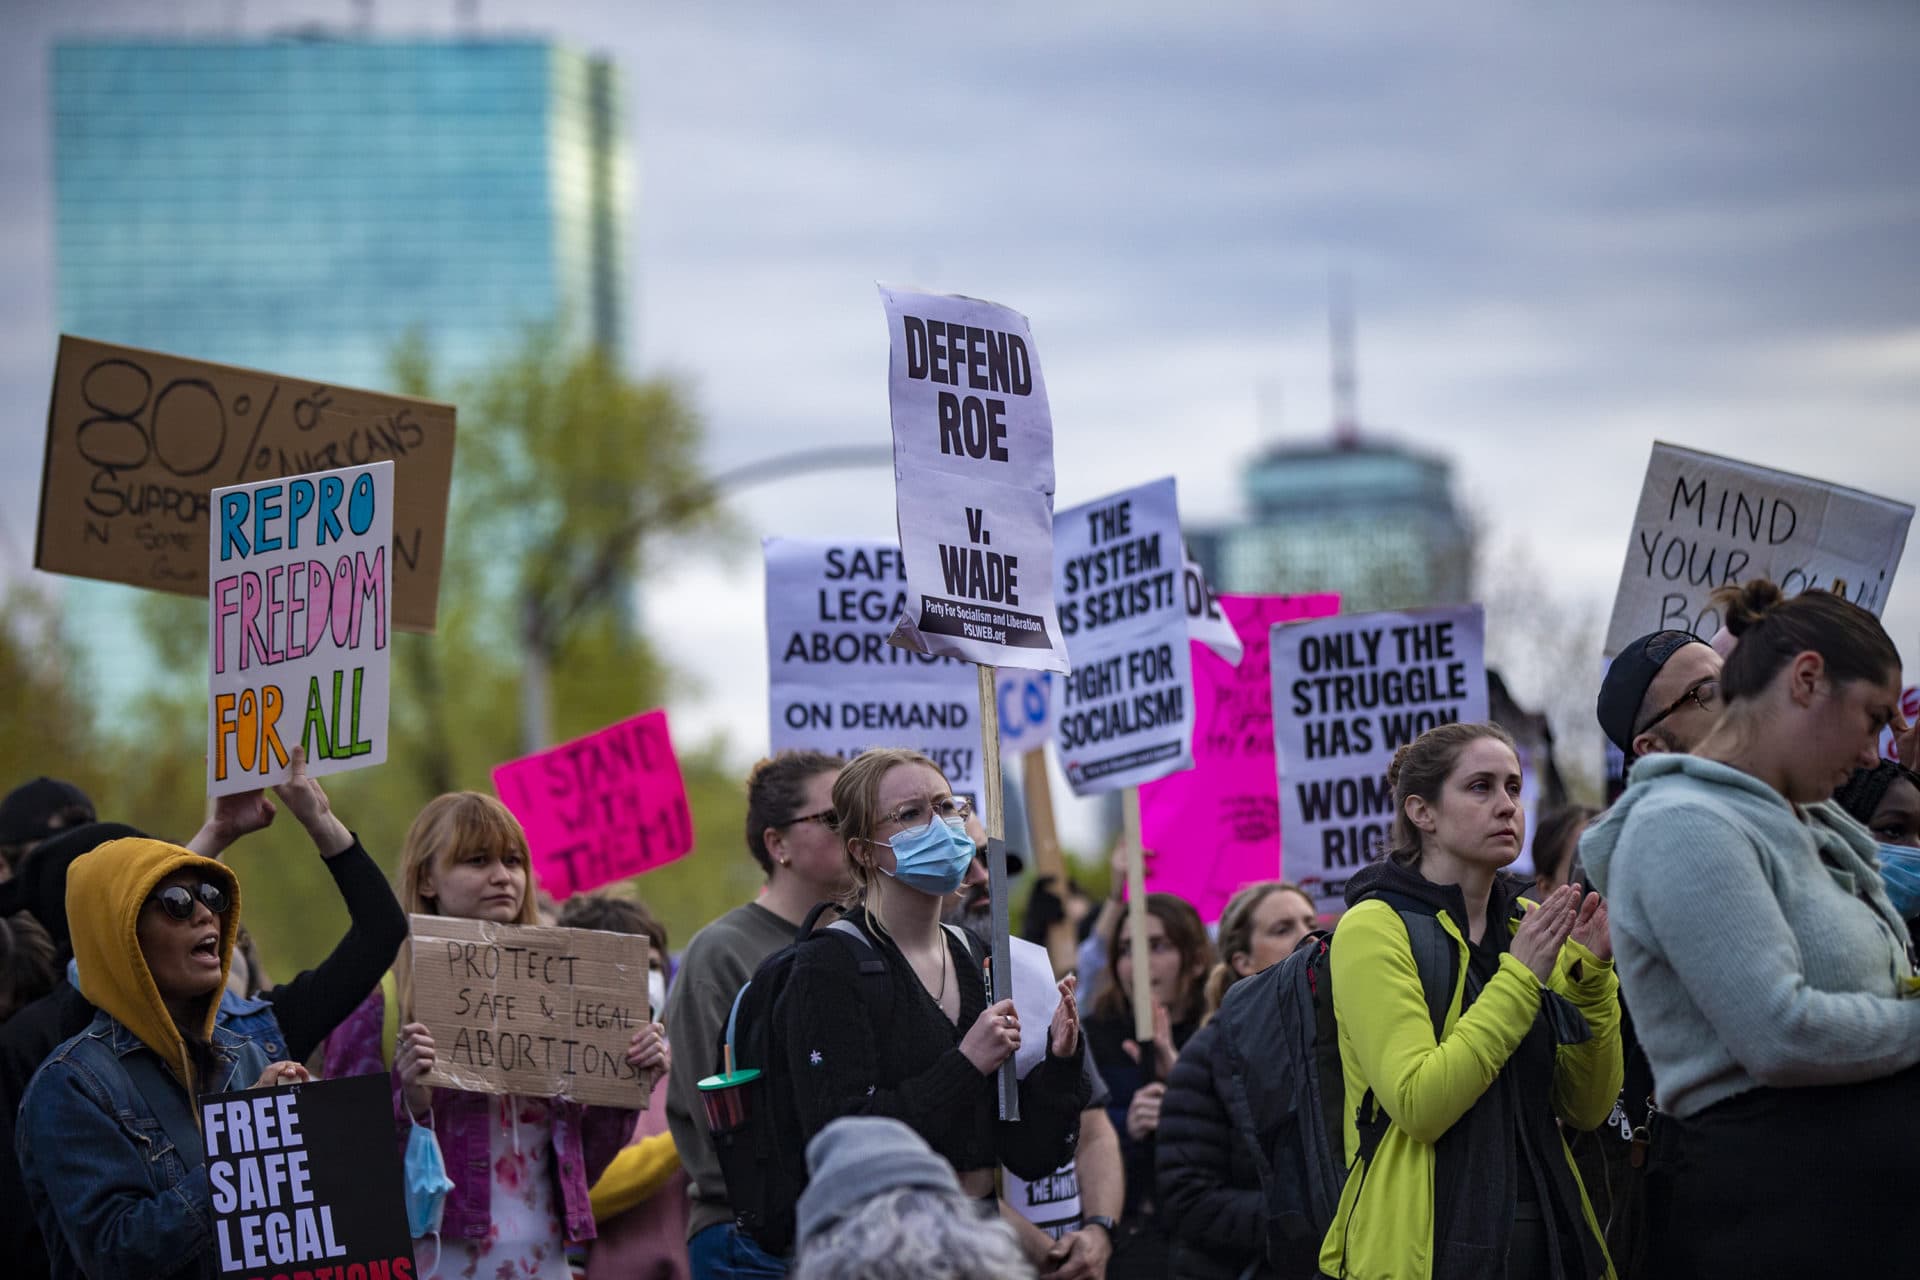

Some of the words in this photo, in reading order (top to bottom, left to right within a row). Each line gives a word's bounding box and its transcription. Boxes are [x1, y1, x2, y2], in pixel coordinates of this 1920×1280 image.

[904, 315, 1033, 397] DEFEND
[76, 359, 280, 479] 80%
[294, 387, 334, 431] OF
[938, 391, 1009, 463] ROE
[84, 469, 210, 522] SUPPOR
[220, 472, 375, 561] REPRO
[965, 507, 991, 545] V.
[1088, 500, 1131, 547] THE
[1668, 475, 1798, 546] MIND
[938, 544, 1019, 607] WADE
[1064, 532, 1162, 595] SYSTEM
[1641, 530, 1750, 588] YOUR
[214, 546, 386, 674] FREEDOM
[925, 600, 944, 618] Party
[944, 603, 956, 617] For
[956, 606, 992, 624] Socialism
[993, 613, 1006, 626] and
[1006, 614, 1042, 632] Liberation
[963, 623, 1007, 645] PSLWEB.org
[1057, 597, 1079, 636] IS
[1084, 571, 1174, 631] SEXIST!
[1064, 657, 1122, 707] FIGHT
[1127, 643, 1174, 691] FOR
[1299, 628, 1384, 674] ONLY
[1392, 621, 1454, 664] THE
[785, 702, 831, 730] ON
[841, 702, 969, 730] DEMAND
[1060, 685, 1184, 752] SOCIALISM!
[1291, 662, 1467, 717] STRUGGLE
[215, 685, 290, 782] FOR
[301, 667, 372, 764] ALL
[1304, 716, 1373, 761] HAS
[544, 725, 663, 797] STAND
[446, 941, 580, 985] PROTECT
[455, 988, 517, 1021] SAFE
[539, 995, 556, 1021] &
[575, 1000, 635, 1029] LEGAL
[450, 1028, 644, 1087] ABORTIONS!
[203, 1094, 304, 1157] FREE
[209, 1150, 314, 1214] SAFE
[216, 1205, 347, 1273] LEGAL
